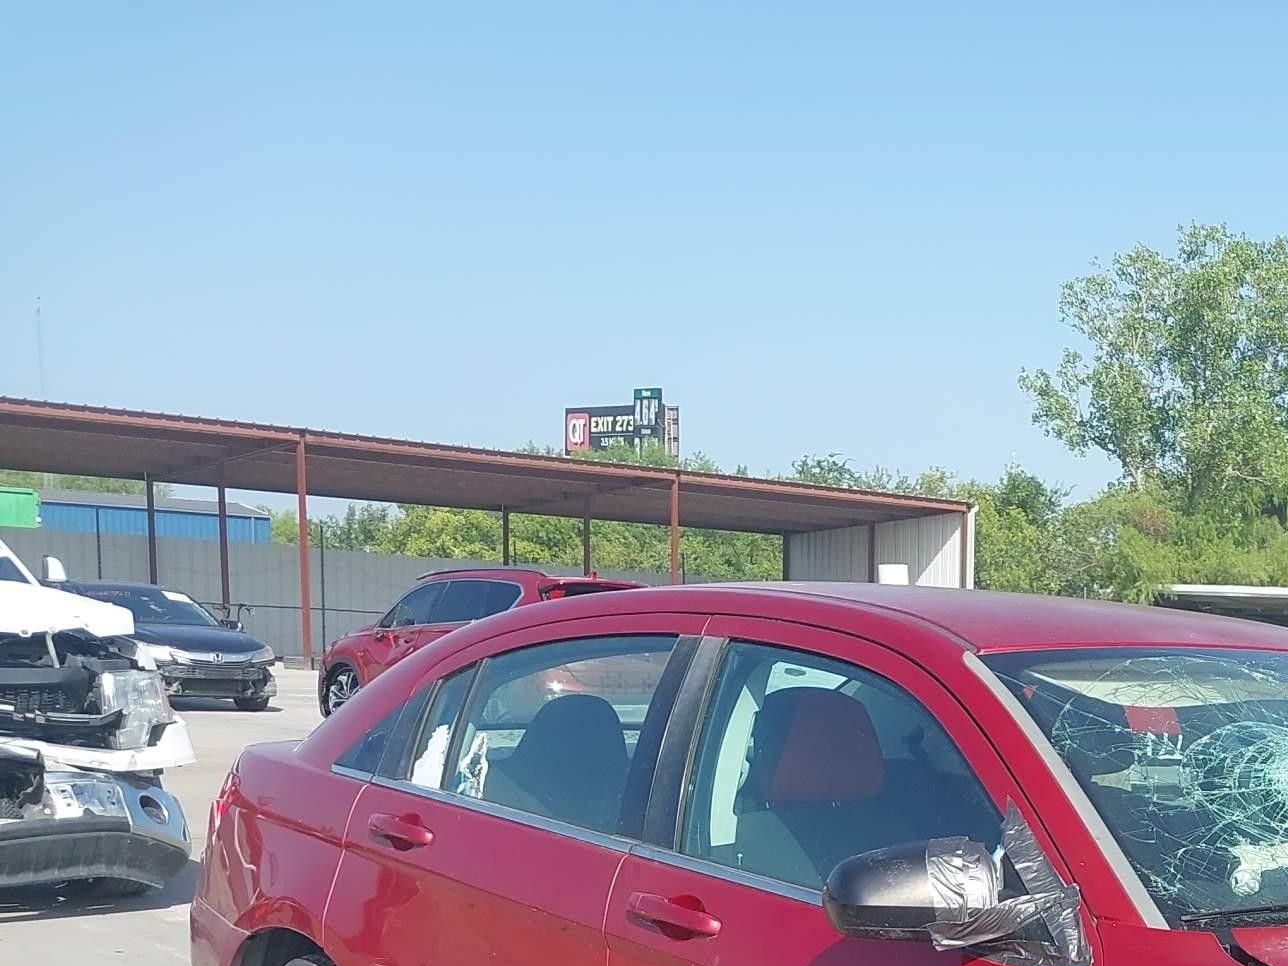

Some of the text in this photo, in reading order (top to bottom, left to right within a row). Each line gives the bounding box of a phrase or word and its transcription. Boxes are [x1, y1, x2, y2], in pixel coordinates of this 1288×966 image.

[569, 418, 586, 445] QT
[591, 416, 614, 433] EXIT
[615, 415, 634, 432] 273
